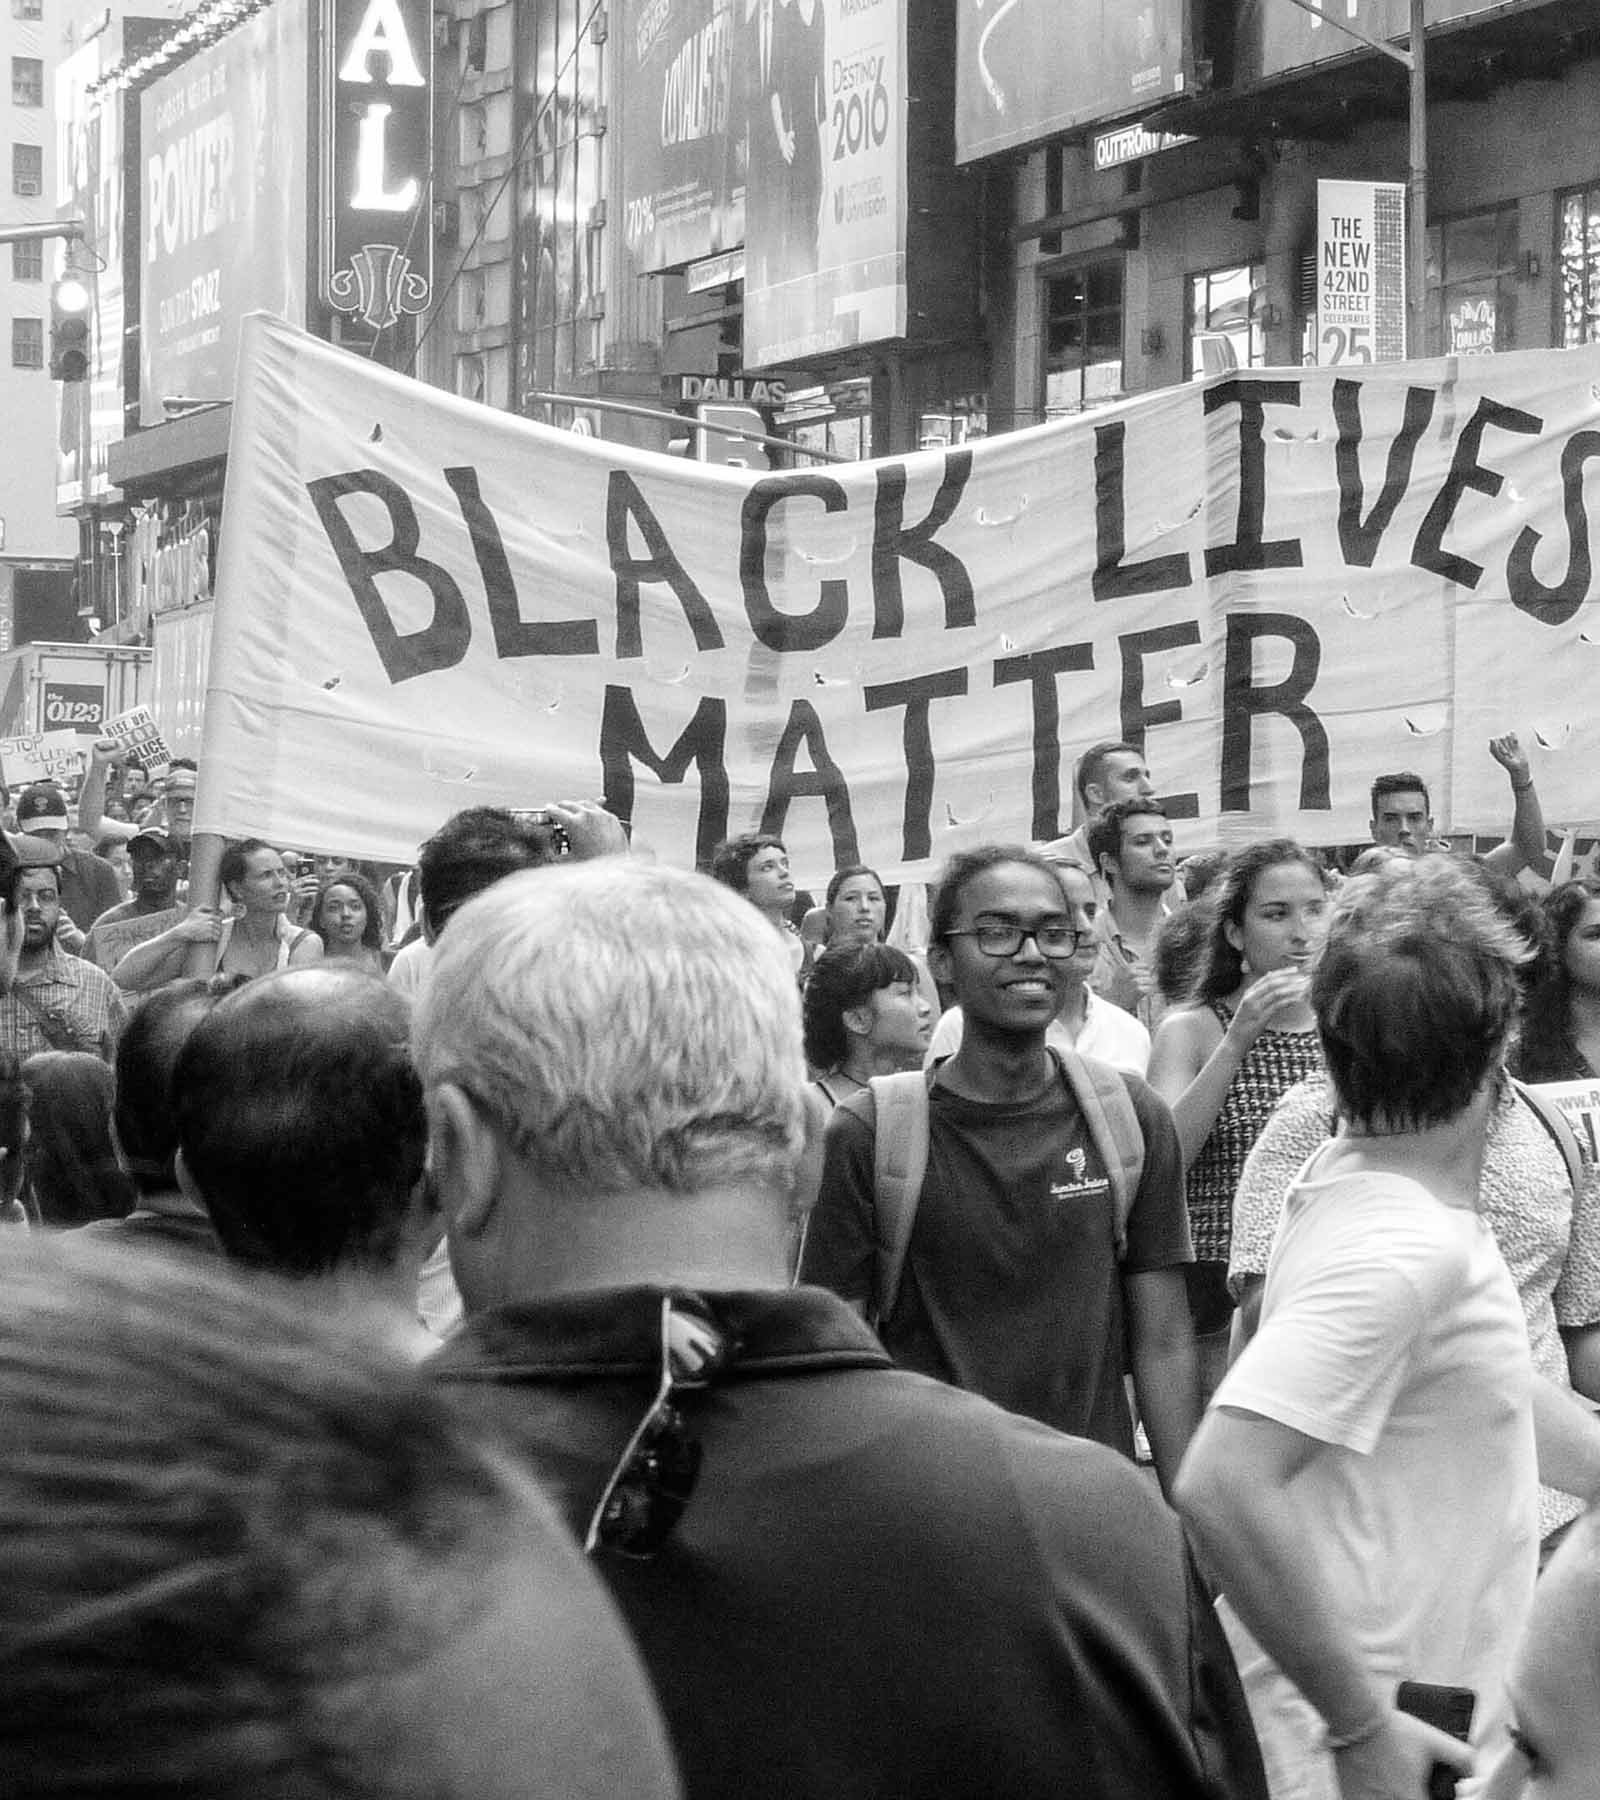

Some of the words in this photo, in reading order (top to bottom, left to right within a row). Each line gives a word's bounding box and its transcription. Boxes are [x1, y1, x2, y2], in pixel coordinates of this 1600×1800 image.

[832, 56, 889, 162] 2016
[147, 112, 237, 263] POWER
[1331, 217, 1362, 239] THE
[1324, 241, 1371, 268] NEW
[1323, 270, 1370, 293] 42ND
[1323, 294, 1371, 311] STREET
[1321, 326, 1372, 366] 25
[682, 376, 787, 403] DALLAS
[305, 450, 978, 684] BLACK
[128, 737, 167, 760] OLICE
[599, 612, 1332, 872] MATTER
